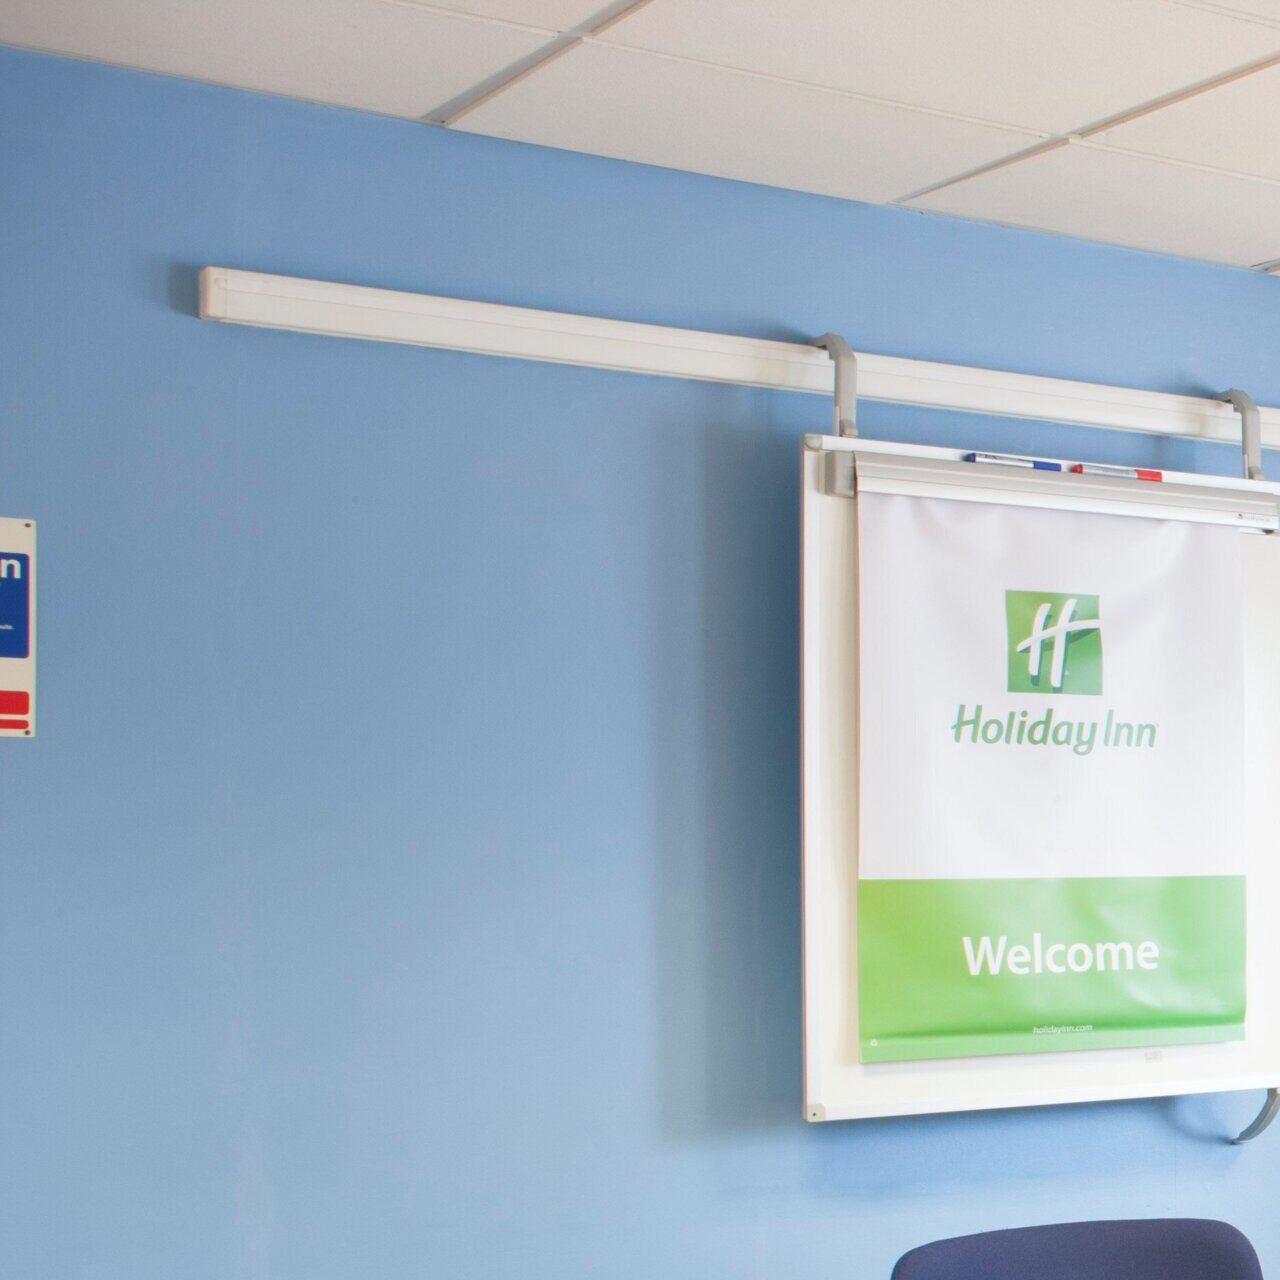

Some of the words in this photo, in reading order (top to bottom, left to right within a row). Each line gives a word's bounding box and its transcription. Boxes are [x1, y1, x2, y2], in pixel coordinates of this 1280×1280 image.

[951, 703, 1097, 756] Holiday
[1103, 708, 1157, 748] Inn
[962, 932, 1159, 976] Welcome
